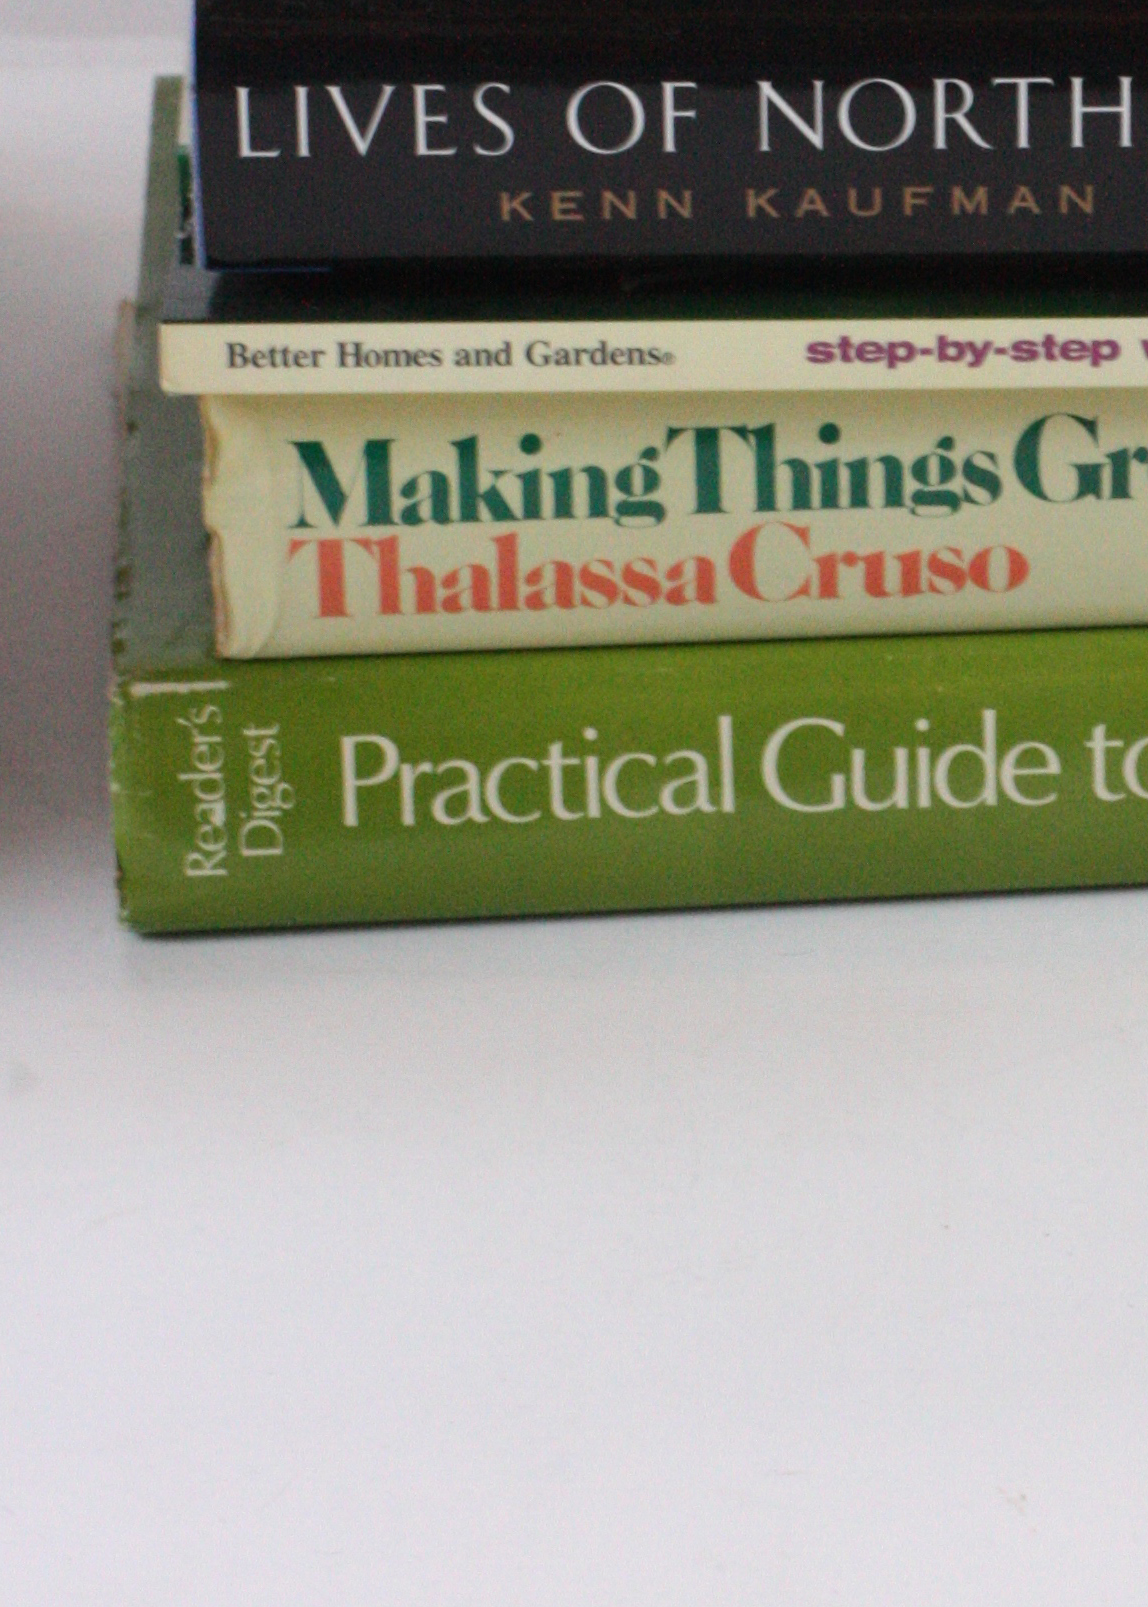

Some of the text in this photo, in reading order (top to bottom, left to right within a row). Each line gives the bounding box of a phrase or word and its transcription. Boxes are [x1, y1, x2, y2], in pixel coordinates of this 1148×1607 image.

[233, 82, 516, 158] LIVES
[564, 81, 699, 155] OF
[755, 75, 1135, 152] NORTH
[499, 186, 1095, 222] KENN KAUFMAN
[225, 342, 328, 369] Better
[335, 341, 443, 369] Homes
[453, 341, 512, 367] and
[805, 334, 1120, 369] step-by-step
[287, 432, 667, 530] Making
[664, 422, 1002, 518] Things
[288, 522, 1031, 619] Thalassa Cruso
[176, 703, 228, 877] Reader's
[239, 722, 296, 858] Digest
[340, 715, 736, 826] Practical
[761, 709, 1062, 813] Guide
